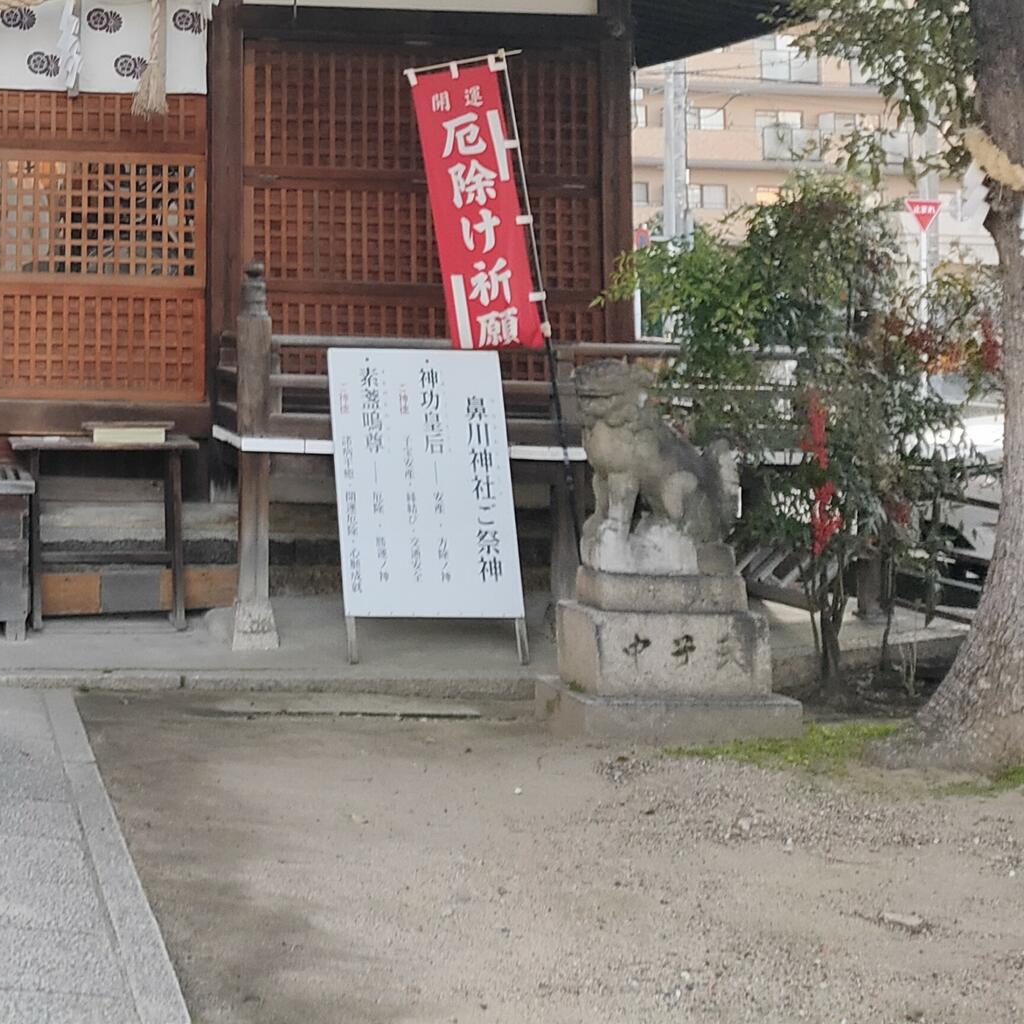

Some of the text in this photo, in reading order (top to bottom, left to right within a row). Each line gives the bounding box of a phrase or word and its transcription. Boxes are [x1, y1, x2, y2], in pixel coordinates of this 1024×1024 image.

[432, 85, 484, 113] 開運
[441, 112, 520, 348] 厄除け祈願
[419, 367, 445, 454] 神功皇后
[465, 395, 503, 583] 鼻川神社ご祭神
